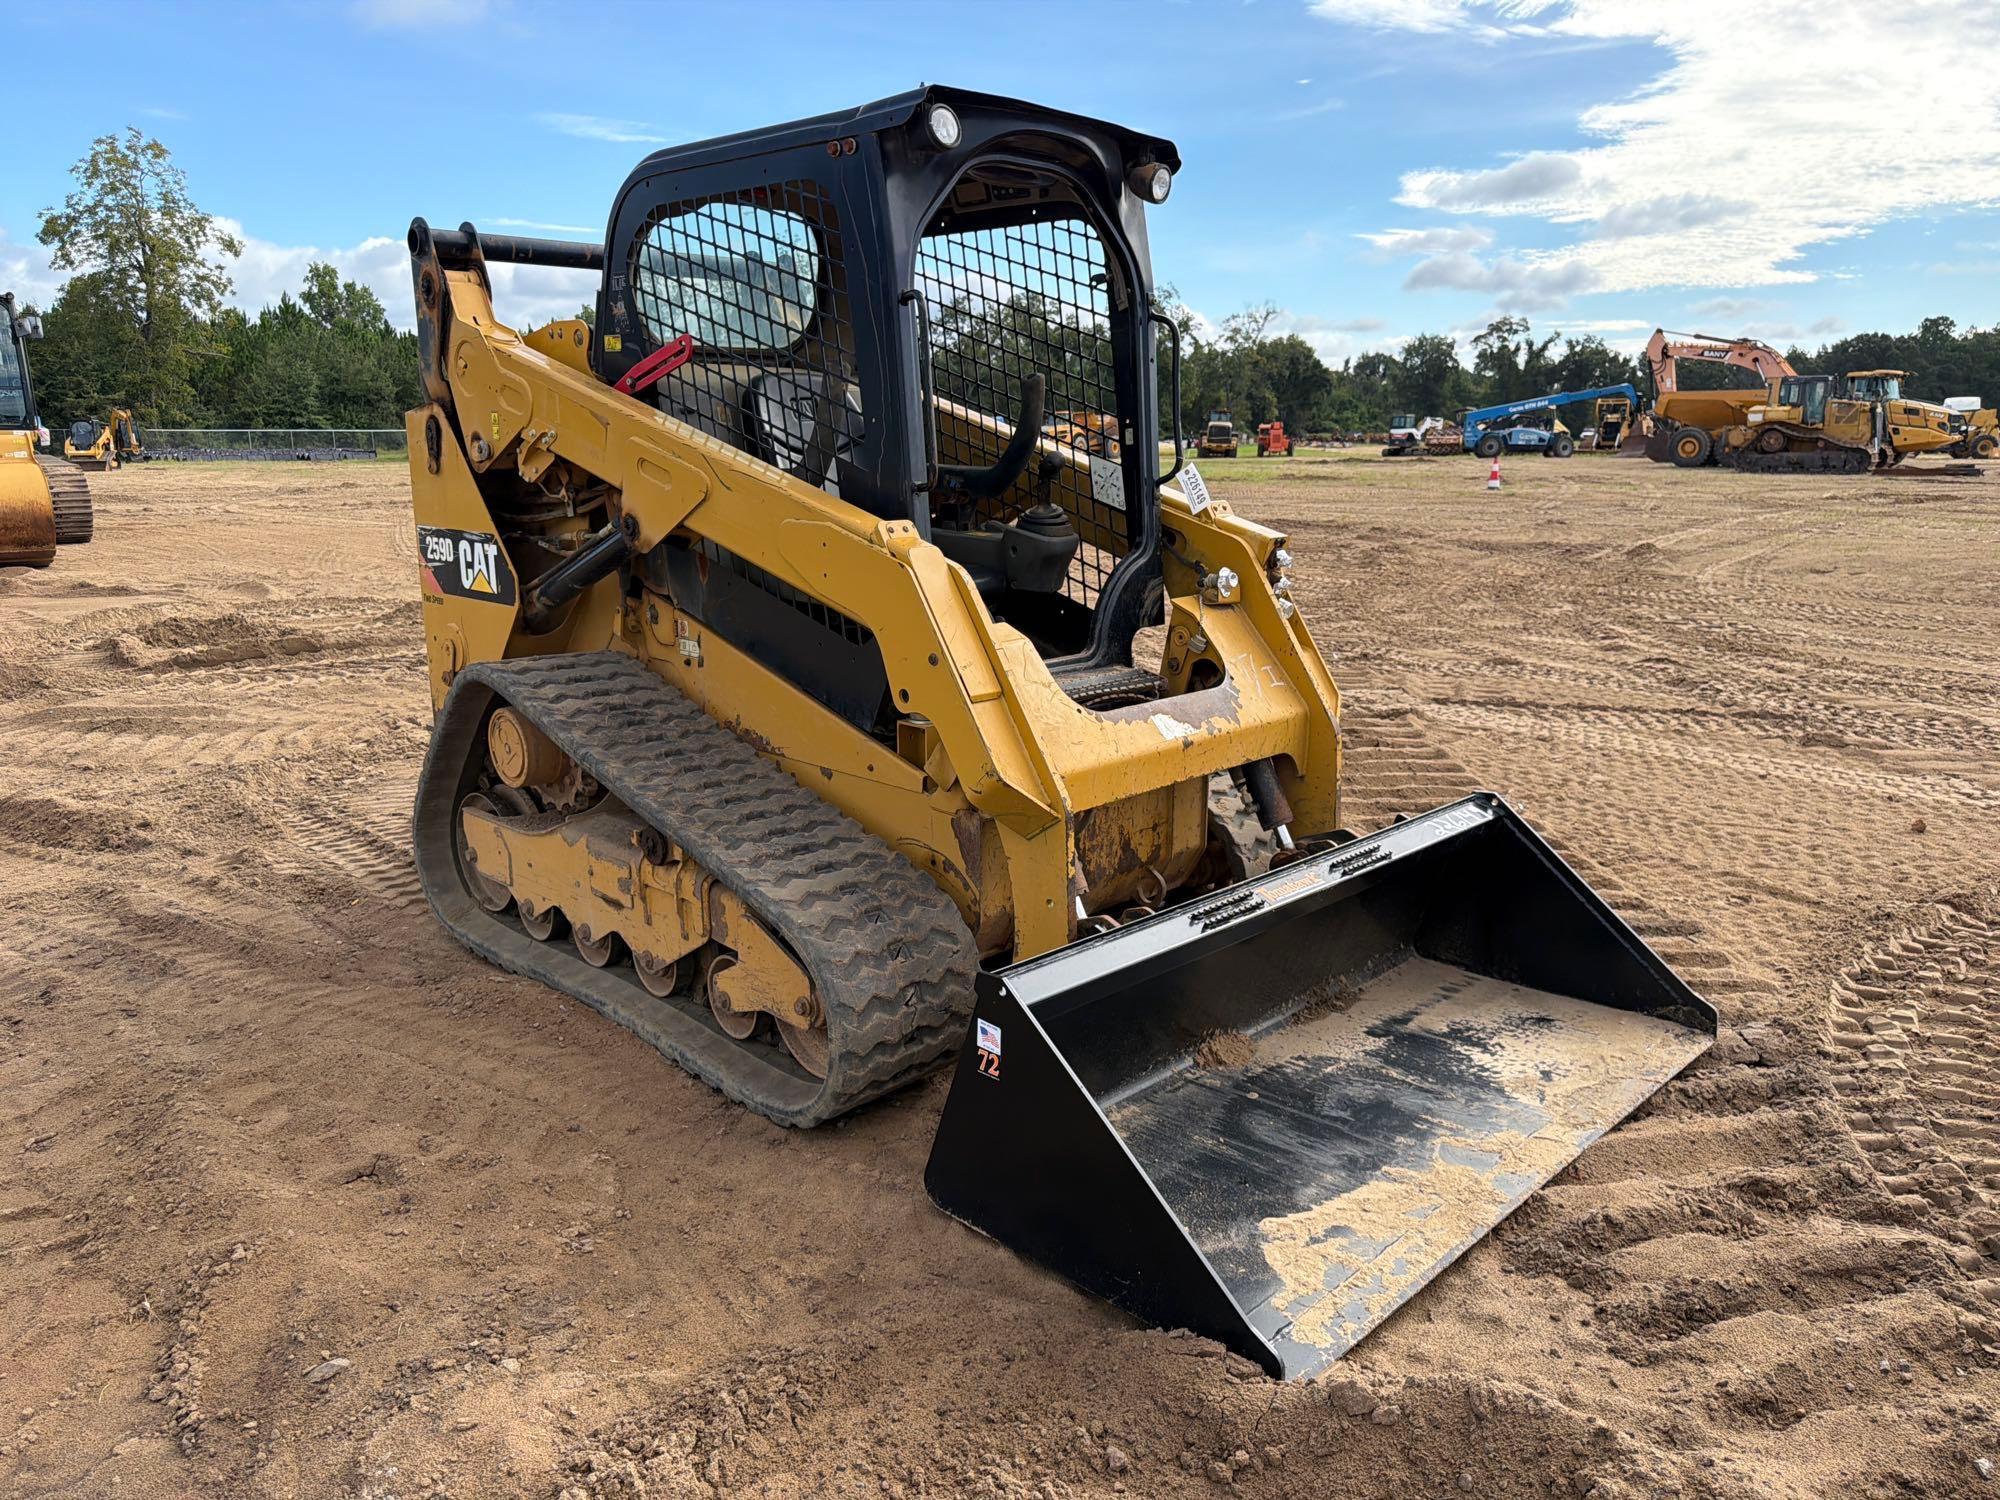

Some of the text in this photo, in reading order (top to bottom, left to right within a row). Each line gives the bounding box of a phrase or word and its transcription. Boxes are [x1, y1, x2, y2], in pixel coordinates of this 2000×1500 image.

[1187, 473, 1207, 505] 226149
[426, 535, 498, 595] 259D CAT
[977, 1048, 1000, 1077] 72
